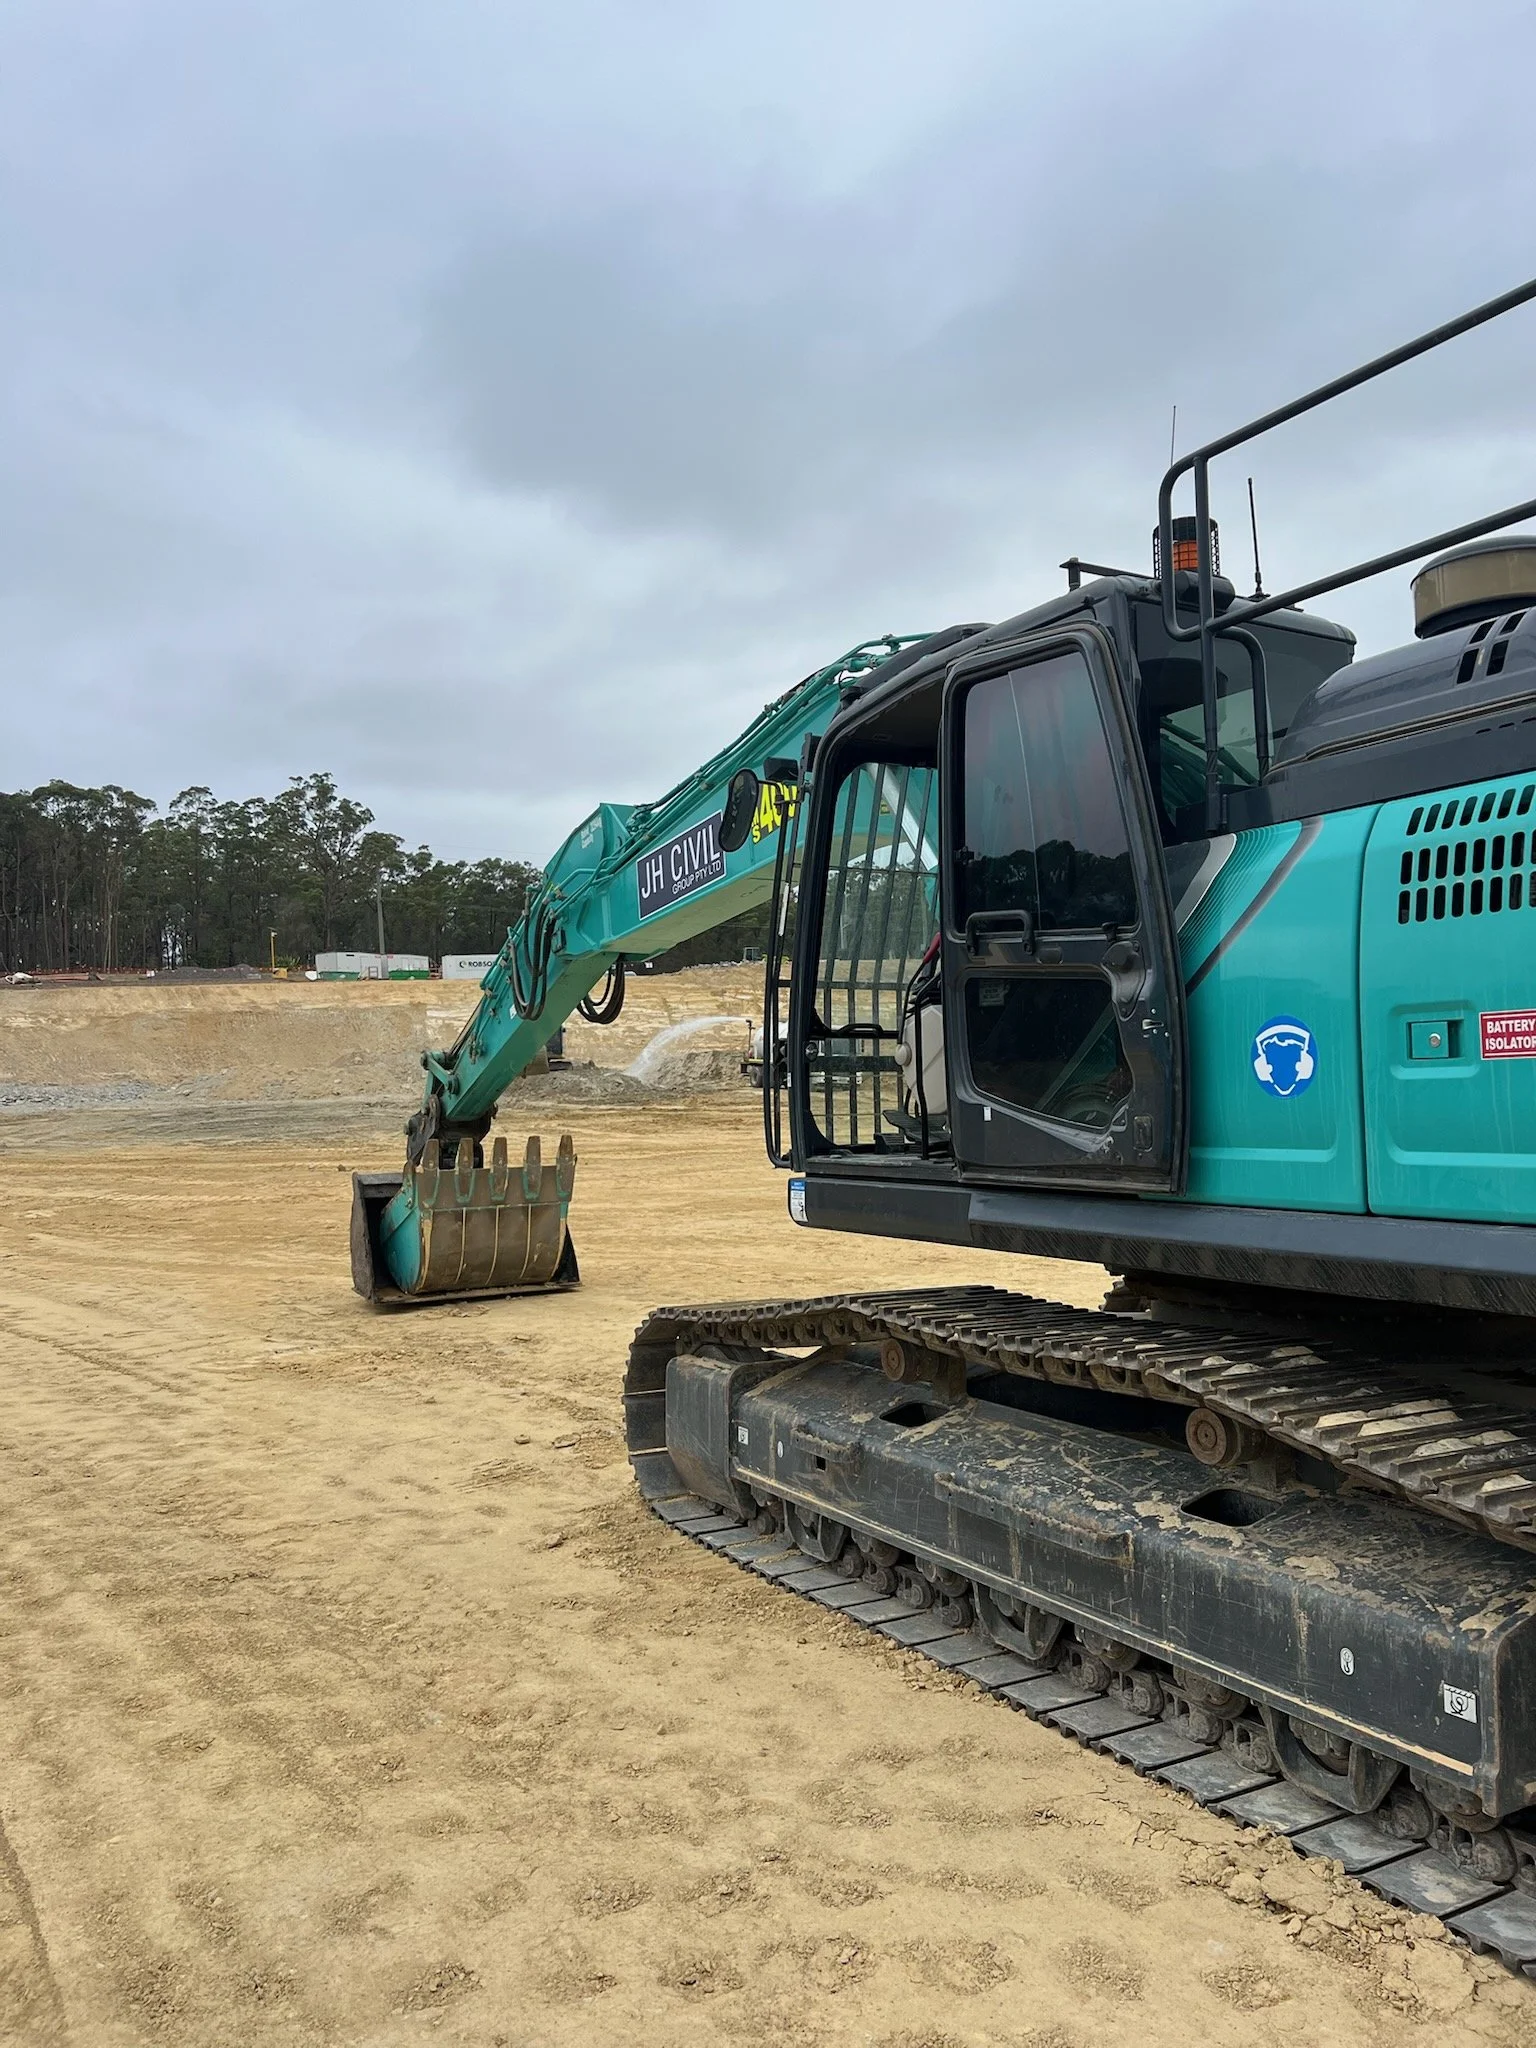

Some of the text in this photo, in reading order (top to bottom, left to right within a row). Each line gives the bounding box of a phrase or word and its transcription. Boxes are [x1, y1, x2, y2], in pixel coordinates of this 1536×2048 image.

[641, 854, 664, 899] JH
[670, 824, 721, 882] CIVIL
[672, 860, 722, 895] GROUP PTY LTD
[468, 960, 495, 968] ROBSO
[1486, 1018, 1536, 1034] BATTERY
